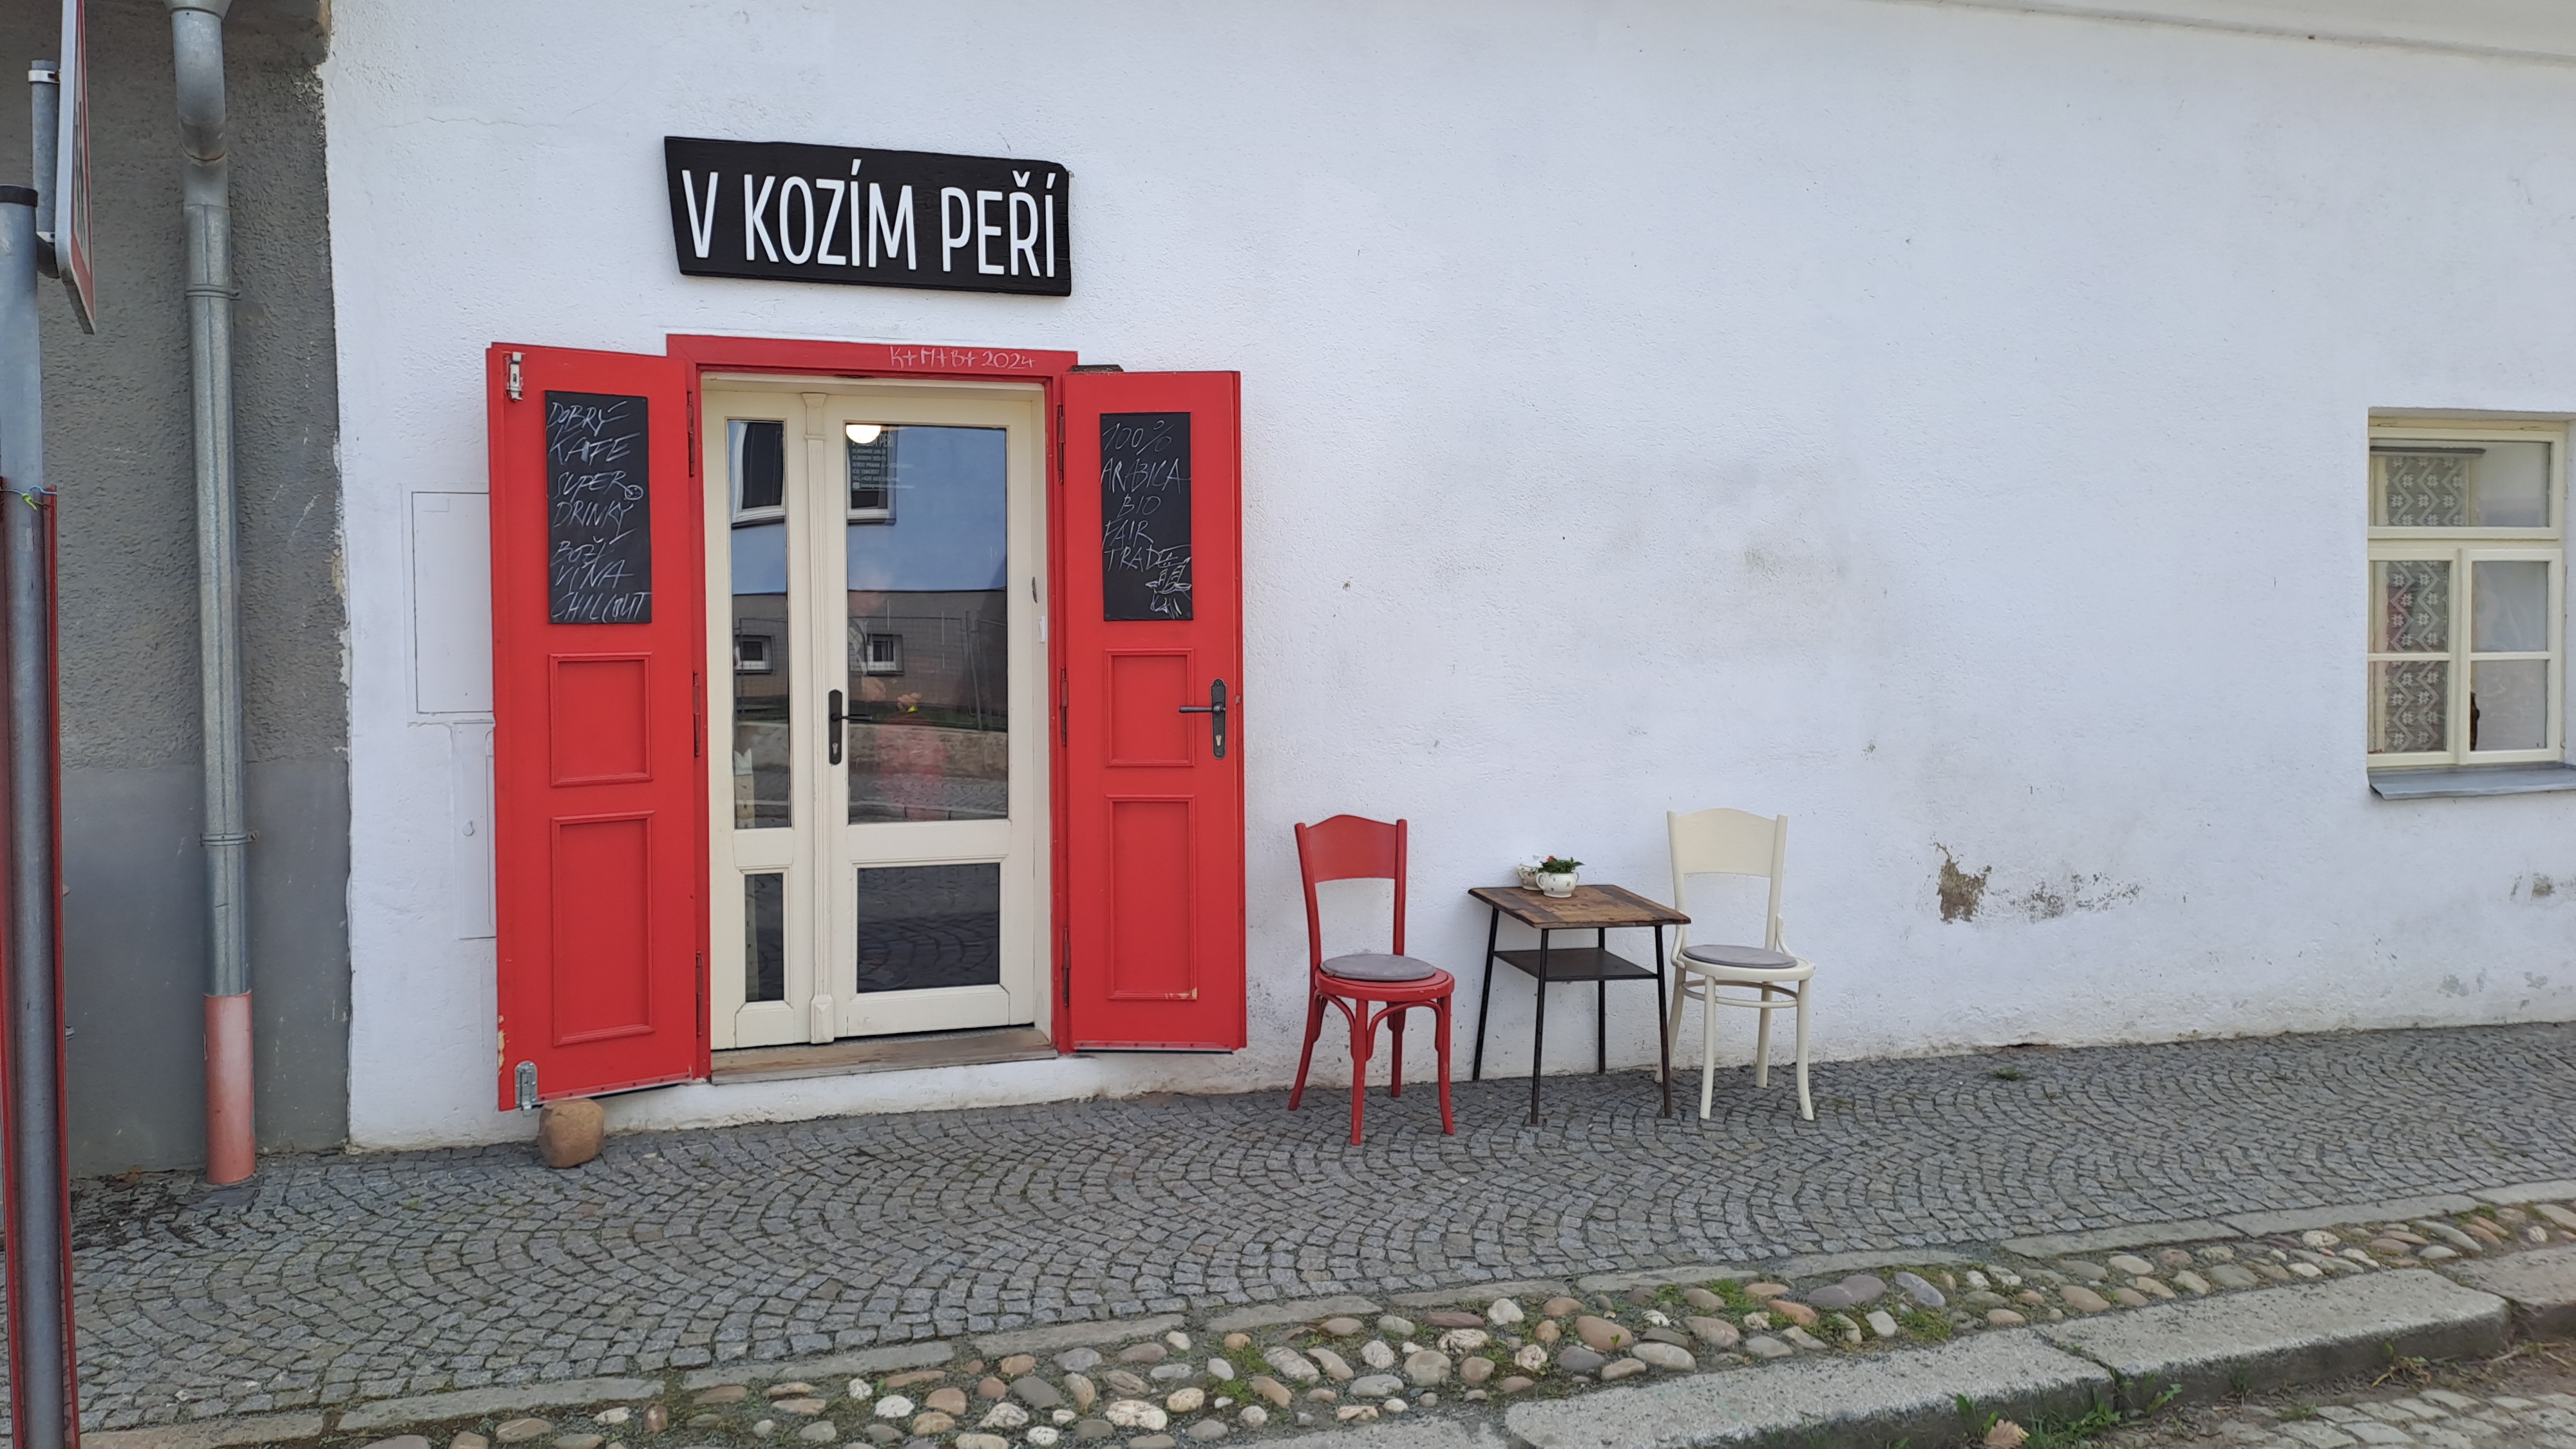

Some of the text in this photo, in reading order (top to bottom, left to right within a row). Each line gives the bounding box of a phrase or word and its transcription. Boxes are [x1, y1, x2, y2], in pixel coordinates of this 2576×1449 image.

[681, 158, 1056, 278] V KOZÍM PEŘÍ
[548, 424, 640, 466] KAFE
[1102, 420, 1175, 456] 100%
[553, 471, 634, 502] SUPER
[1101, 457, 1191, 493] ARABICA
[553, 500, 634, 537] DRINKY
[1117, 494, 1161, 518] BIO
[1102, 518, 1153, 549] FAIR
[1104, 545, 1191, 572] TRADE
